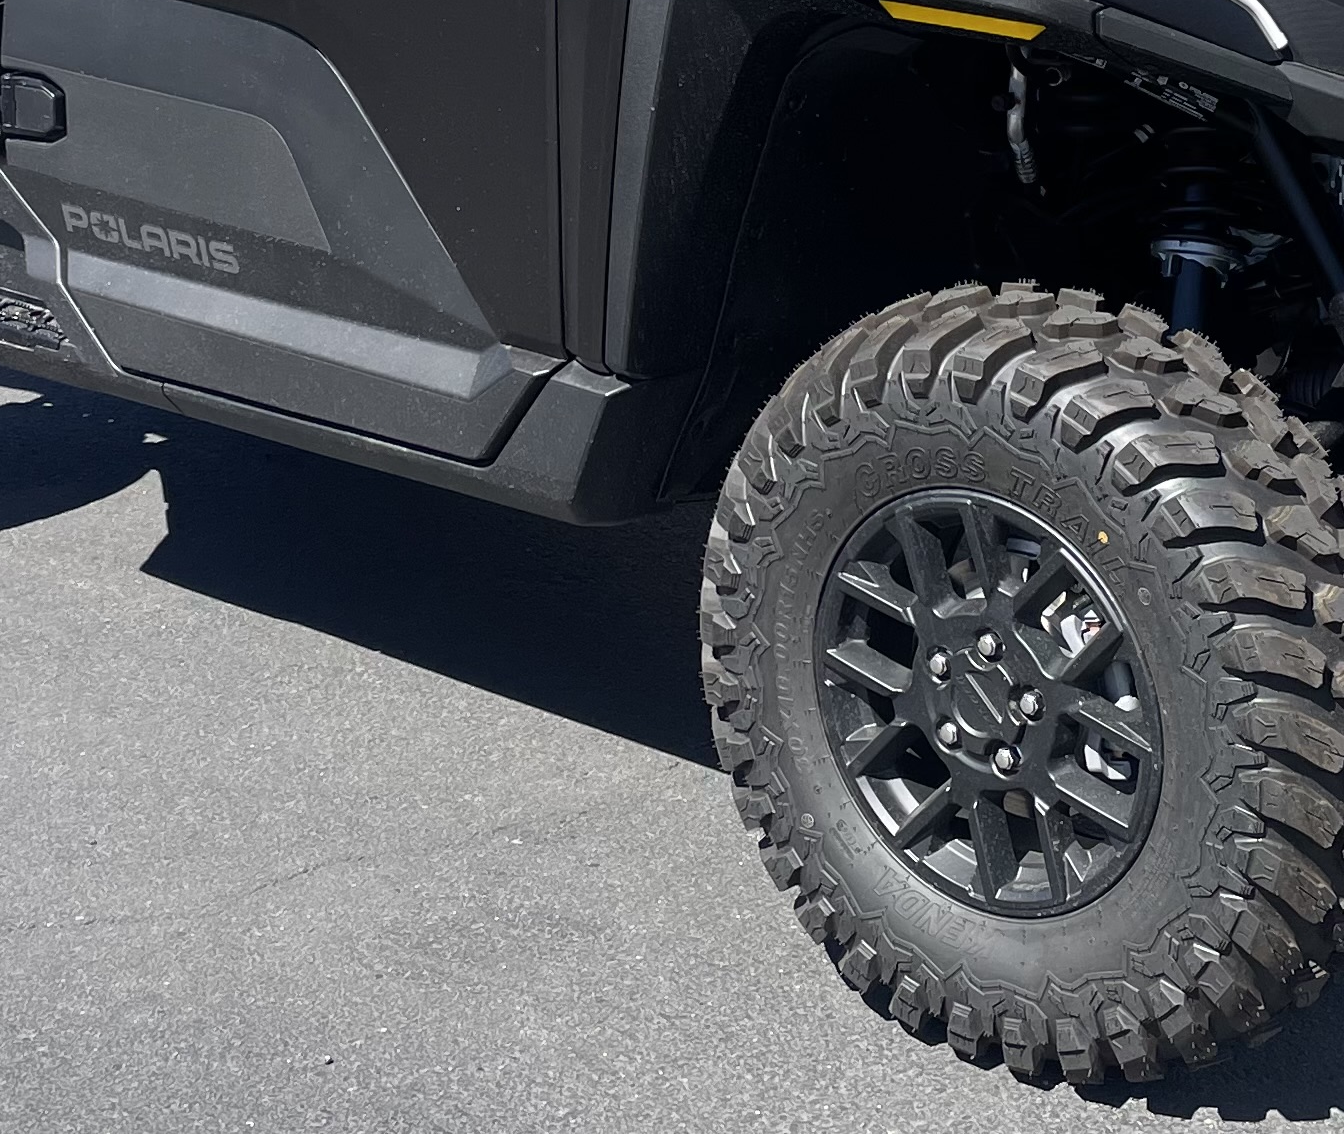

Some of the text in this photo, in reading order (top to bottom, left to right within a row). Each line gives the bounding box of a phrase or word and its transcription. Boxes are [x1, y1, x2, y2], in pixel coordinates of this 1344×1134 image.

[62, 204, 240, 275] POLARIS
[854, 446, 1128, 588] CROSS TRAIL
[872, 866, 1004, 962] KENDA
